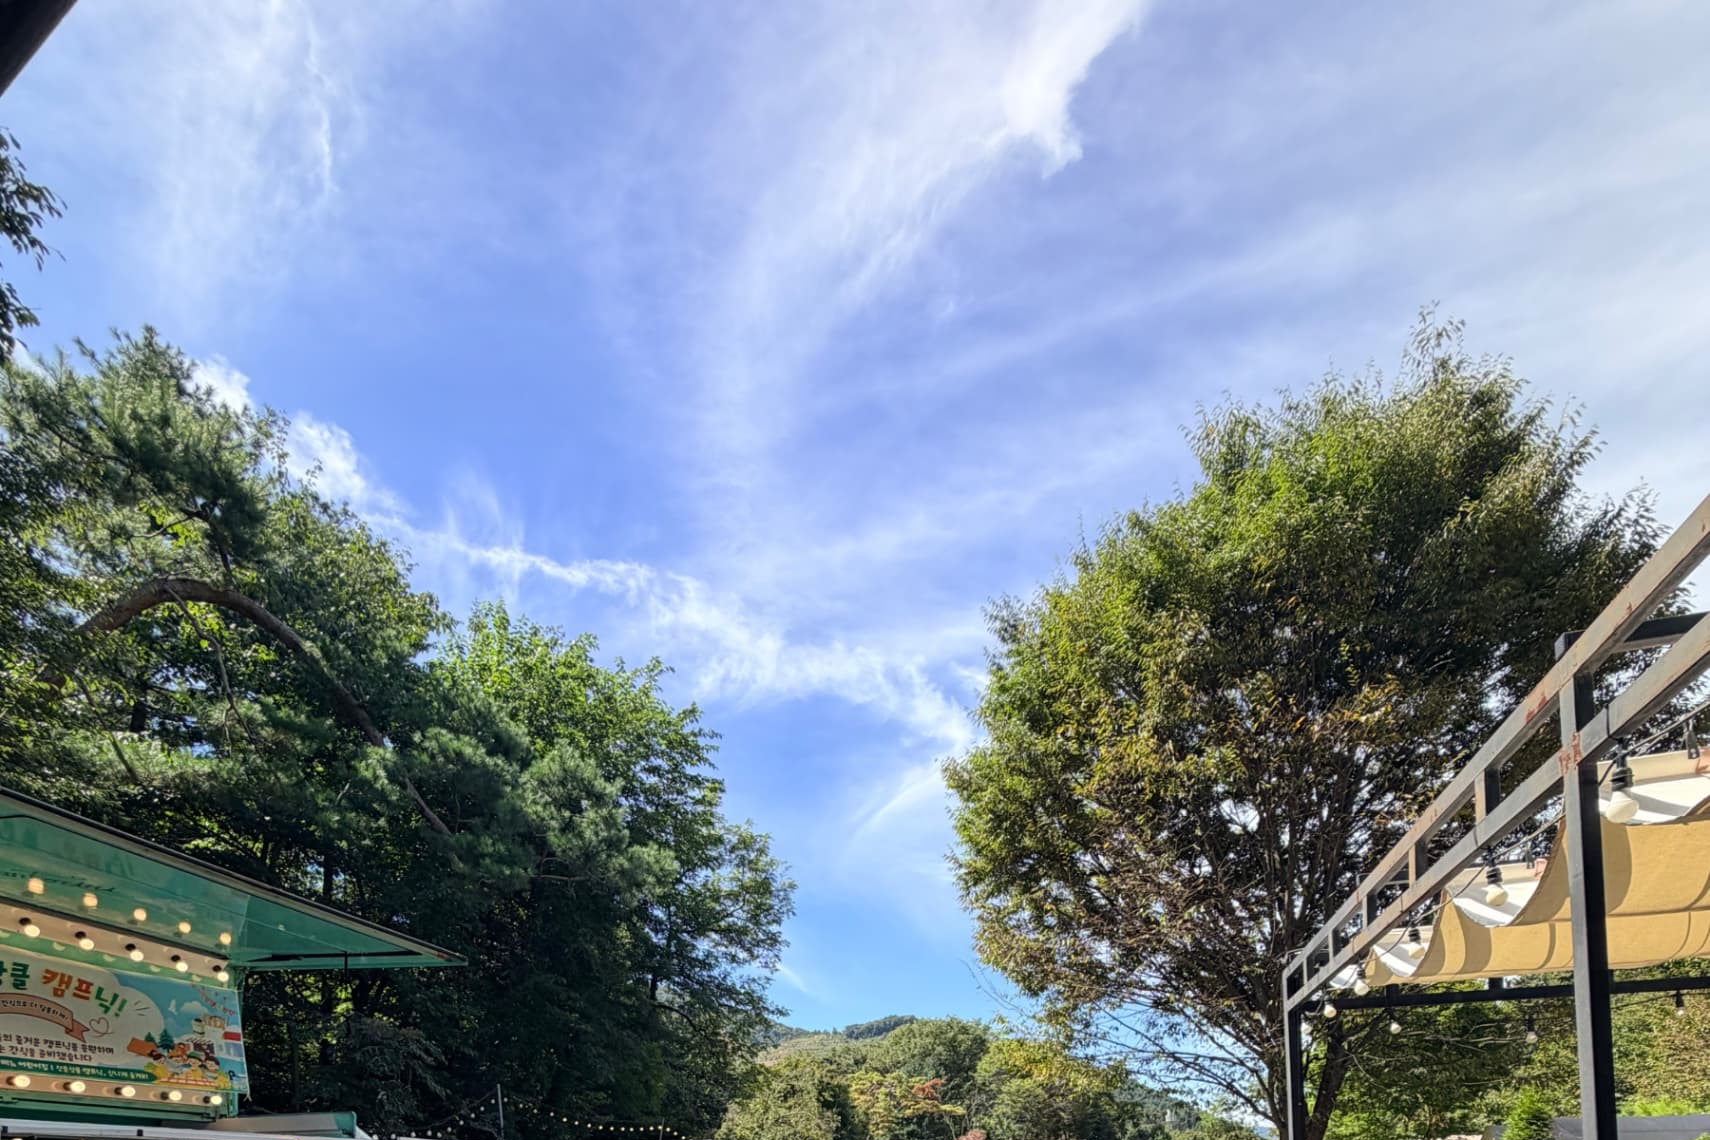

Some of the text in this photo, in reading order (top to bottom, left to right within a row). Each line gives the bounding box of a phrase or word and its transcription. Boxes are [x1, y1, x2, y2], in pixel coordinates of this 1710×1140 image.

[41, 968, 127, 1017] 캠프닉!
[16, 1035, 40, 1047] 즐거운
[8, 1045, 35, 1058] 간식을
[39, 1049, 92, 1062] 준비했습니다
